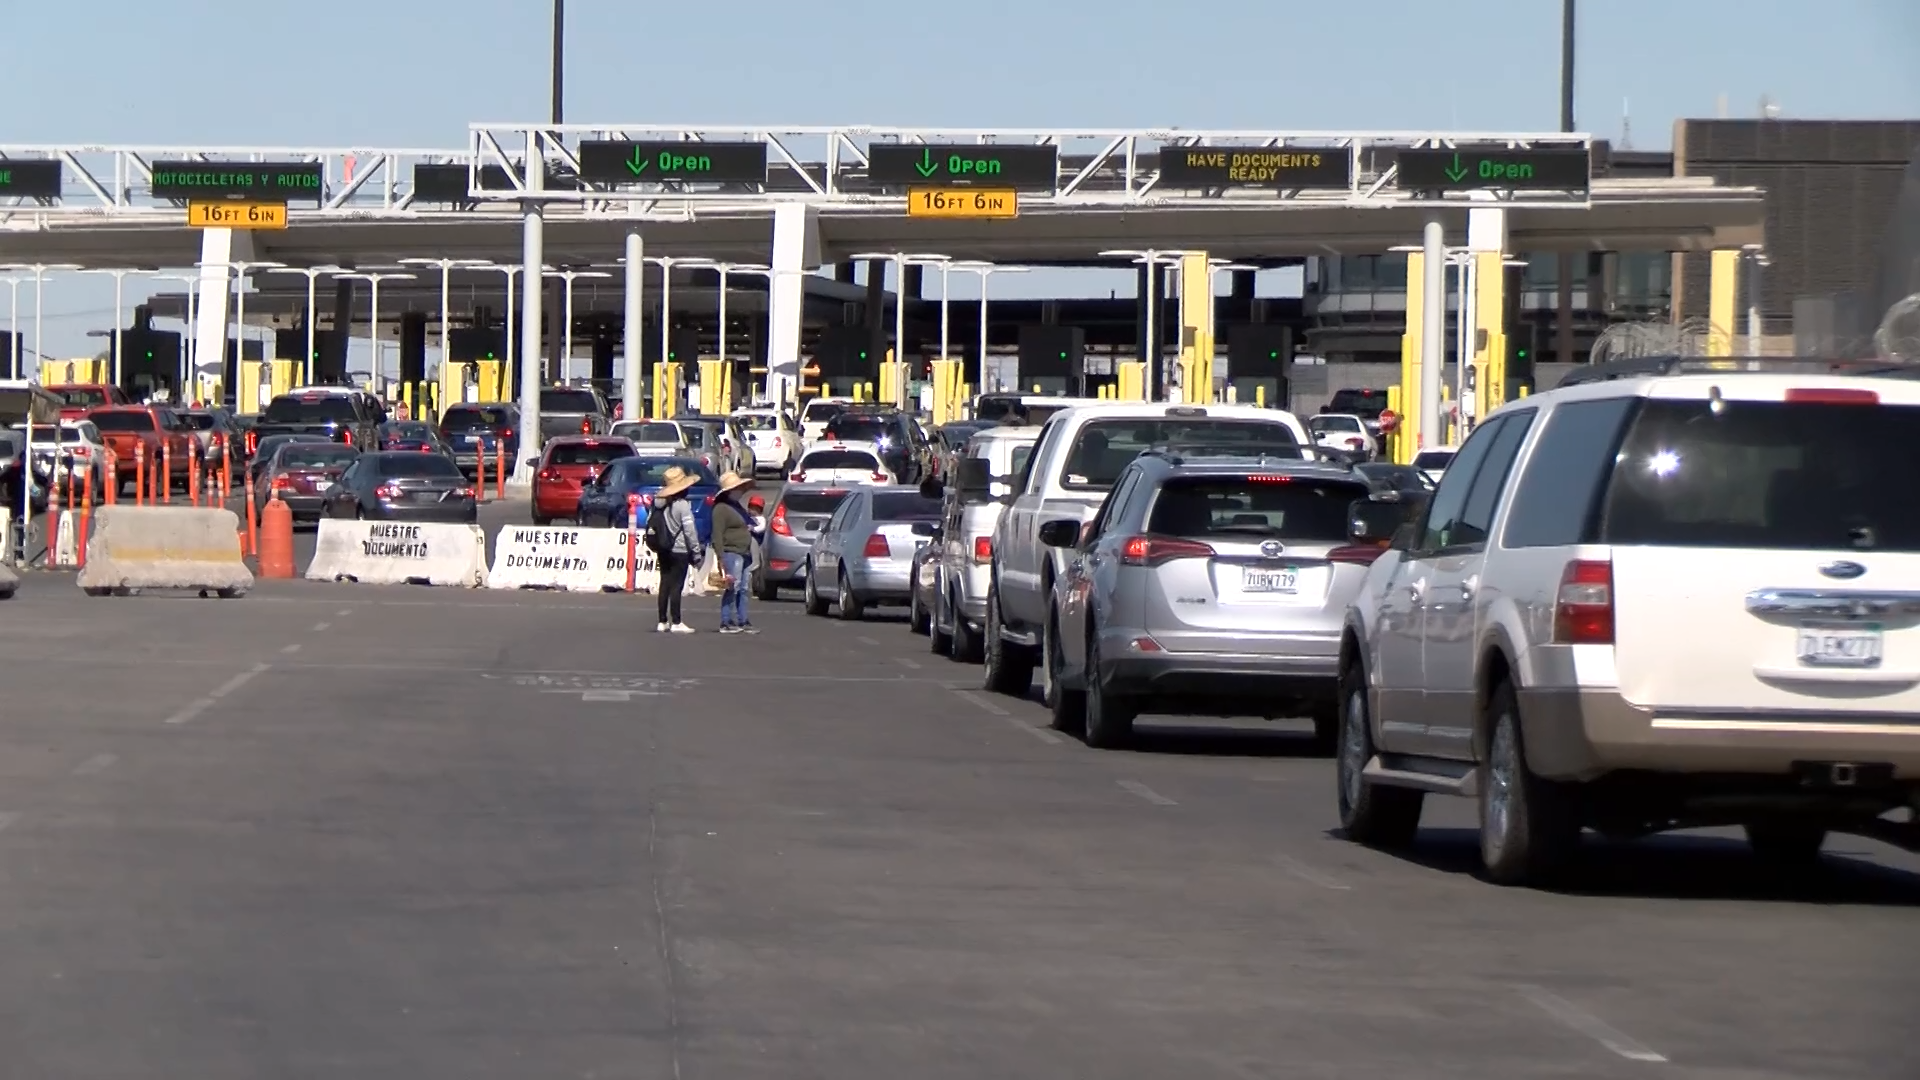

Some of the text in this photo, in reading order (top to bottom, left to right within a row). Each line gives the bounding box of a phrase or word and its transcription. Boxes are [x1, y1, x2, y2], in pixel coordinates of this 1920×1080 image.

[659, 152, 711, 172] Open
[948, 155, 1001, 175] Open
[1186, 153, 1320, 168] HAVE DOCUMENTS
[1229, 167, 1278, 181] READY
[1478, 160, 1533, 179] Open
[153, 172, 320, 187] MOTOCICLETAS Y AUTOS
[369, 524, 422, 539] MUESTRE
[514, 530, 579, 545] MUESTRE
[363, 540, 429, 557] DOCUMENTO
[506, 554, 588, 571] DOCUMENTO
